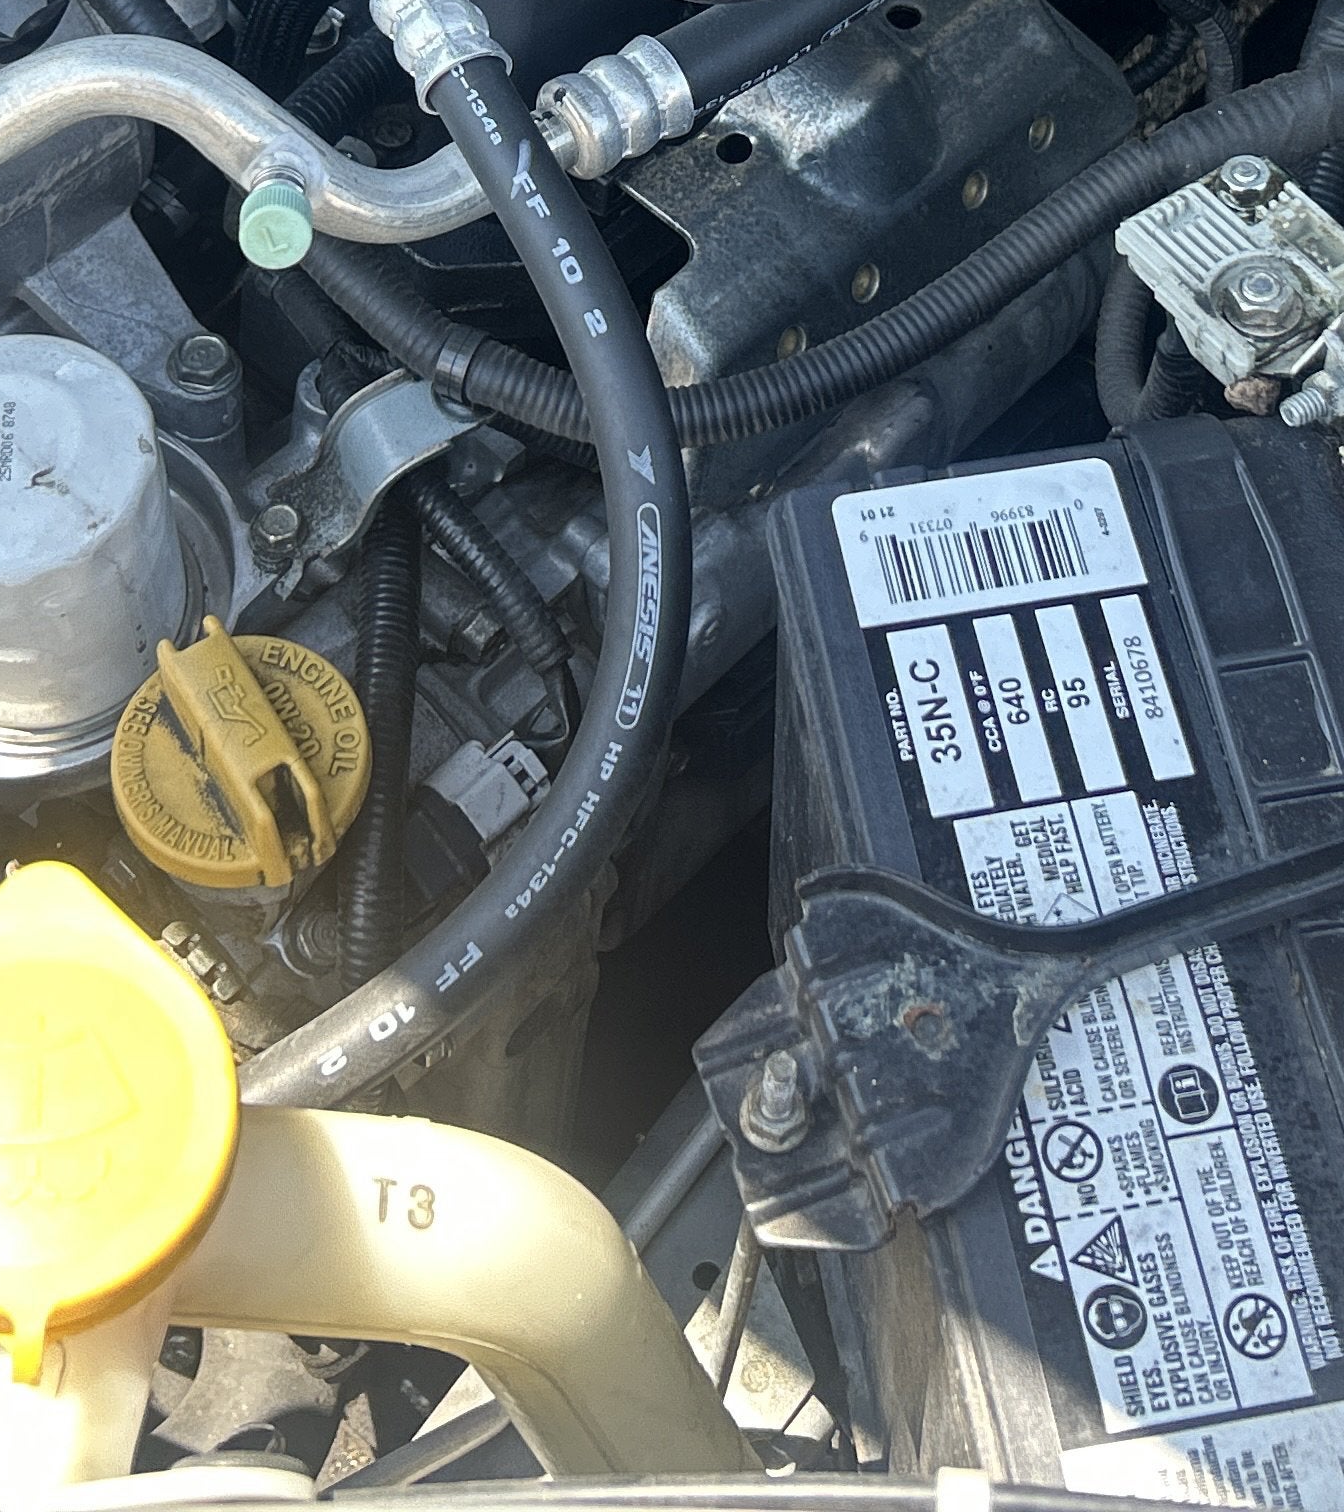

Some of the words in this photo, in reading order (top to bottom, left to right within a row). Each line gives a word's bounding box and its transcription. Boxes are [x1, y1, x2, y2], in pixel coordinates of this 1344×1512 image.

[550, 236, 585, 285] 10
[583, 307, 609, 340] 2
[2, 401, 17, 428] 8748
[990, 504, 1035, 523] 83996
[1073, 498, 1084, 511] 0
[859, 530, 869, 544] 9
[910, 517, 954, 535] 07331
[634, 520, 662, 666] ANESIS
[1060, 676, 1092, 709] 95
[1101, 660, 1130, 719] SERIAL
[1122, 634, 1165, 720] 8410678
[122, 696, 158, 737] SEE
[261, 641, 356, 724] ENGINE
[330, 727, 361, 778] OIL
[883, 686, 903, 717] NO.
[906, 657, 964, 765] 35N-C
[996, 676, 1032, 725] 640
[1040, 687, 1059, 713] RC
[891, 718, 914, 761] PART
[980, 715, 1003, 752] CCA
[119, 739, 163, 821] OWNER'S
[597, 739, 624, 782] HP
[155, 813, 237, 862] MANUAL
[1008, 817, 1033, 848] GET
[1044, 811, 1073, 853] FAST.
[1089, 798, 1121, 856] BATTERY.
[1159, 800, 1198, 885] STRUCTIONS.
[504, 789, 601, 919] HFC-134a
[1027, 815, 1060, 882] MEDICAL
[968, 869, 995, 909] EYES
[1002, 851, 1035, 910] WATER.
[1057, 856, 1084, 894] HELP
[1106, 857, 1132, 894] OPEN
[1124, 859, 1147, 886] TIP.
[433, 941, 484, 994] FF
[1146, 991, 1167, 1017] ALL
[1197, 985, 1220, 1014] NOT
[1209, 963, 1240, 1019] PROPER
[368, 1003, 418, 1042] 10
[1154, 1019, 1179, 1056] READ
[1206, 1013, 1227, 1036] DO
[317, 1049, 349, 1076] 2
[1083, 1025, 1112, 1073] CAUSE
[1103, 1023, 1132, 1077] SEVERE
[1225, 1019, 1259, 1076] FOLLOW
[1061, 1067, 1089, 1107] ACID
[1096, 1073, 1120, 1103] CAN
[1117, 1078, 1137, 1099] OR
[1229, 1089, 1250, 1112] OR
[1105, 1133, 1137, 1191] SPARKS
[1123, 1129, 1155, 1188] FLAMES
[1136, 1116, 1172, 1186] SMOKING
[1235, 1112, 1274, 1191] EXPLOSION
[1253, 1111, 1289, 1180] INVERTED
[1004, 1106, 1052, 1244] DANGE
[1075, 1182, 1099, 1206] NO
[1196, 1164, 1219, 1194] THE
[1204, 1134, 1242, 1213] CHILDREN.
[1204, 1193, 1225, 1217] OF
[1274, 1179, 1299, 1211] FOR
[1211, 1218, 1234, 1250] OUT
[1228, 1212, 1248, 1233] OF
[1271, 1232, 1293, 1254] OF
[1135, 1251, 1169, 1309] GASES
[1153, 1231, 1192, 1316] BLINDNESS
[1221, 1252, 1247, 1289] KEEP
[1234, 1235, 1265, 1286] REACH
[1278, 1254, 1304, 1290] RISK
[1151, 1310, 1196, 1407] EXPLOSIVE
[1177, 1317, 1206, 1369] CAUSE
[1318, 1326, 1344, 1360] NOT
[1113, 1354, 1147, 1417] SHIELD
[1139, 1358, 1171, 1412] EYES.
[1191, 1371, 1215, 1404] CAN
[1211, 1377, 1232, 1400] OR
